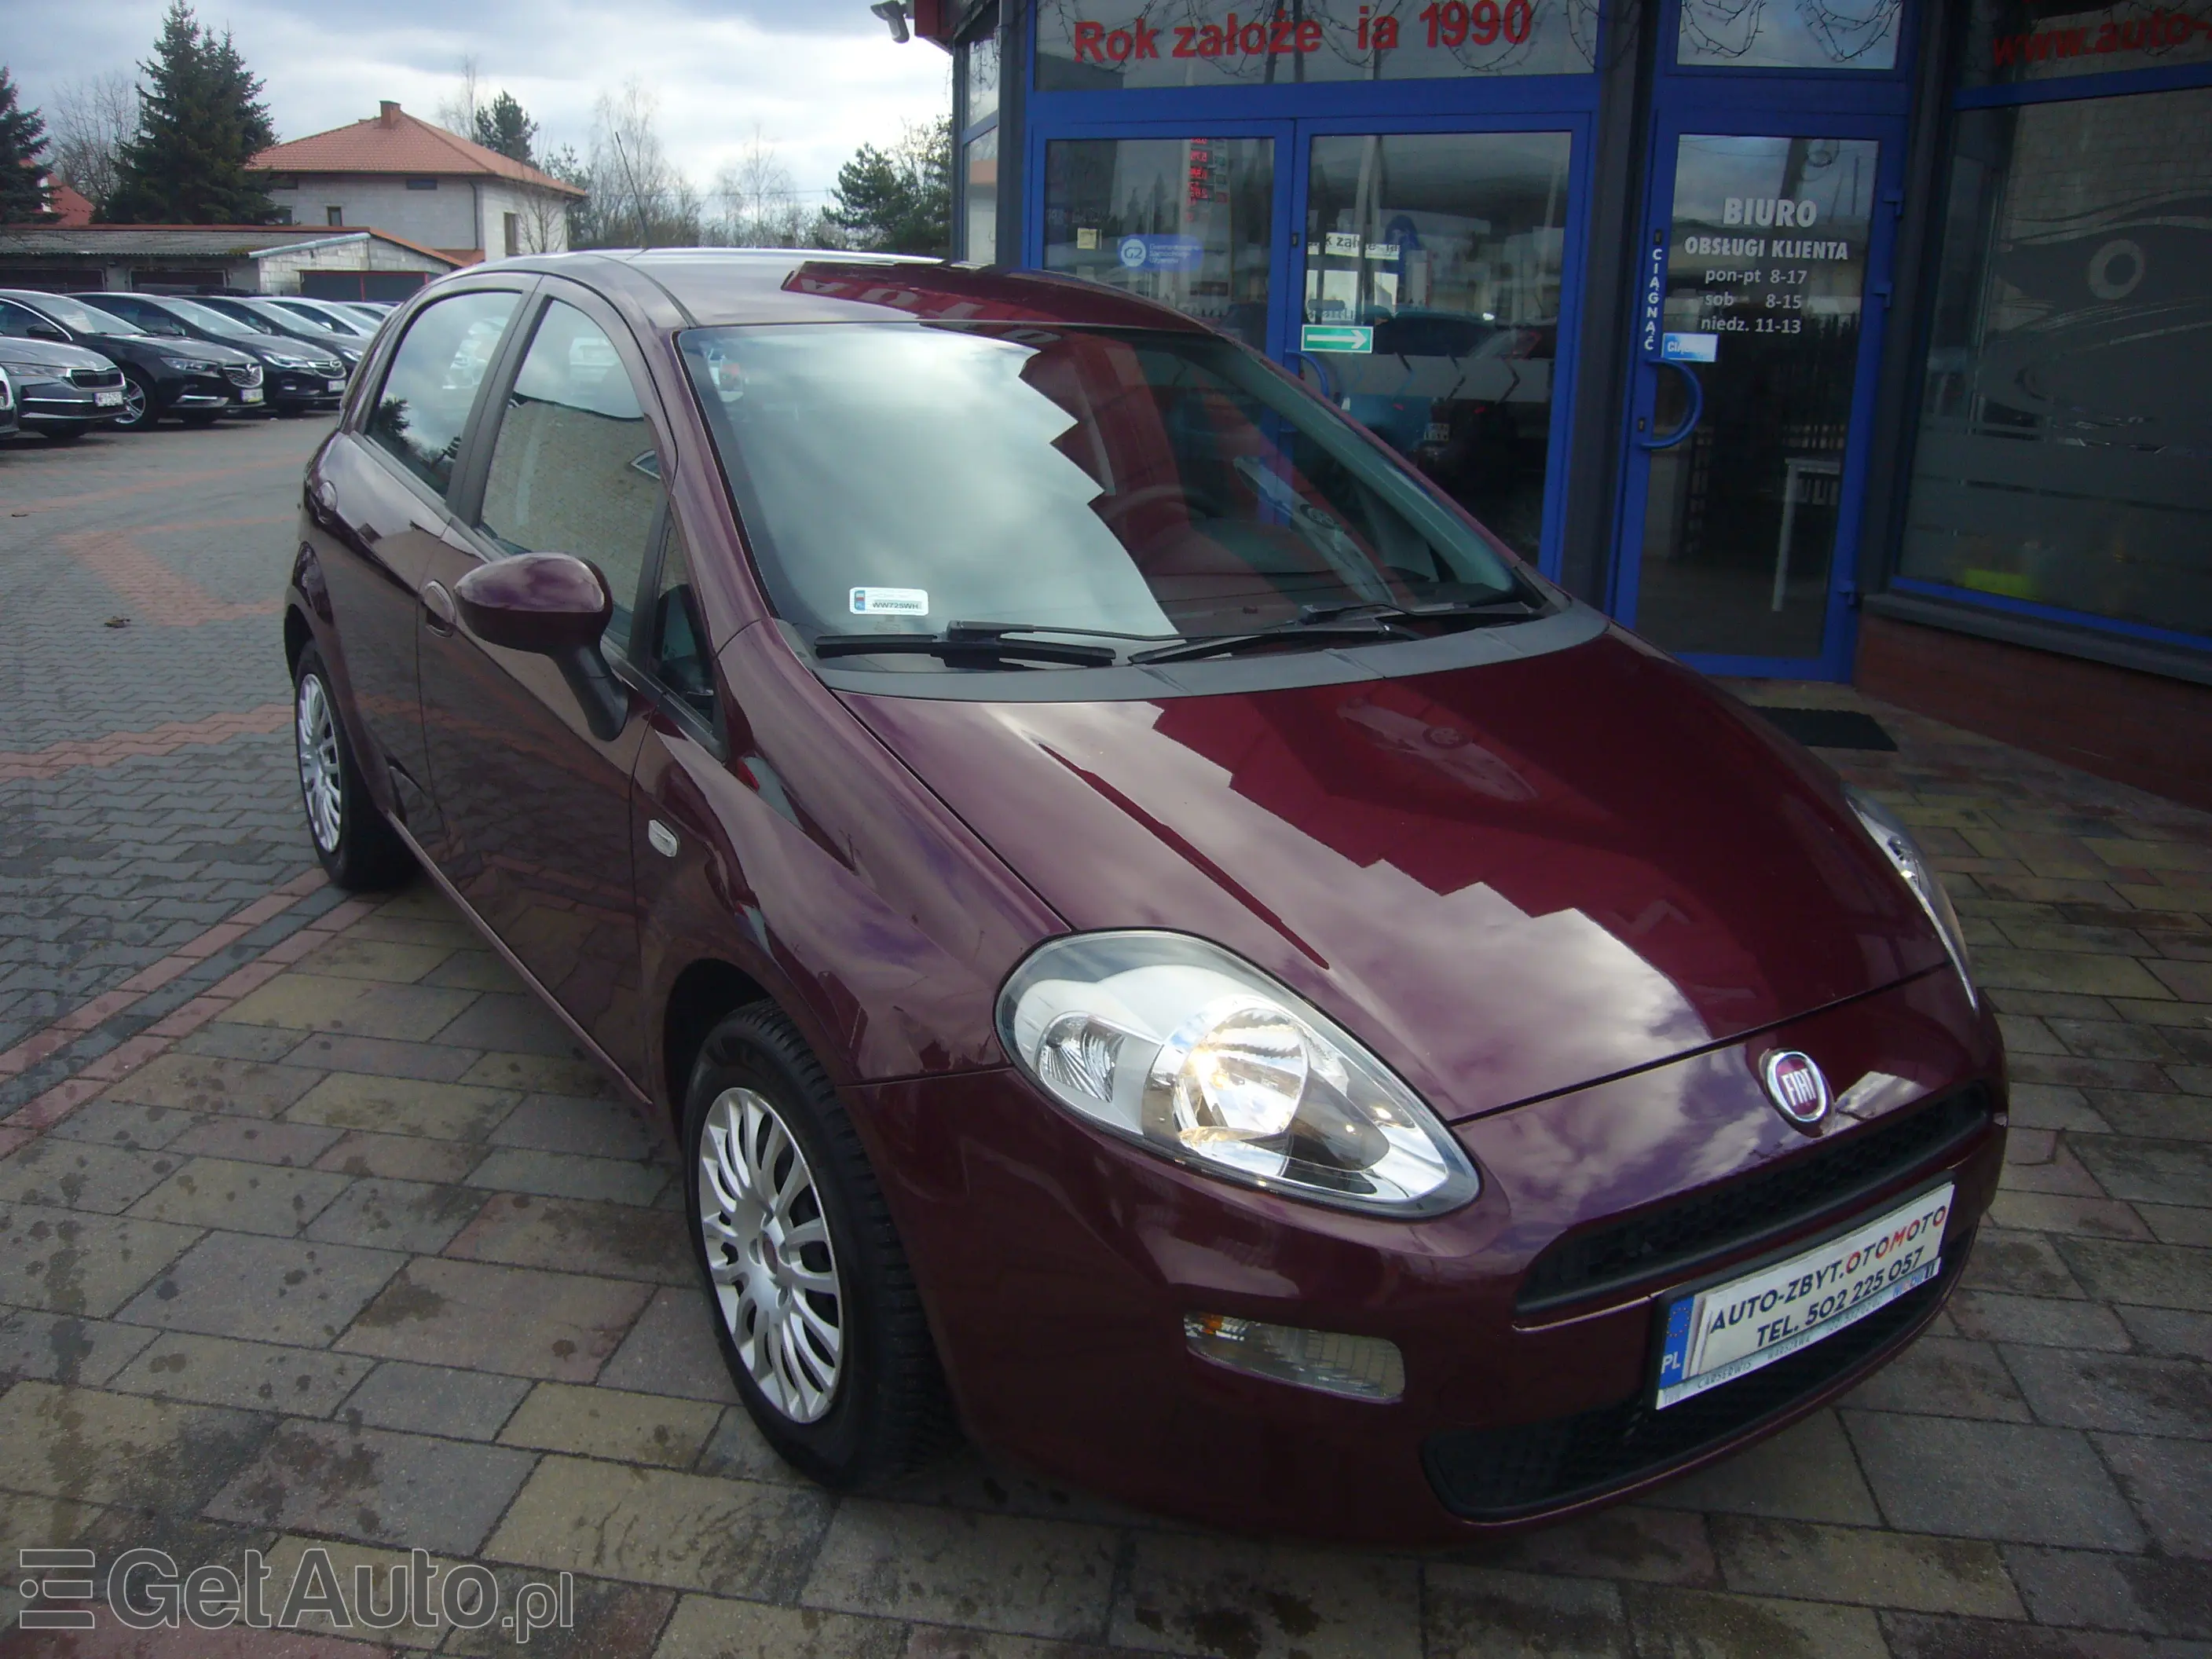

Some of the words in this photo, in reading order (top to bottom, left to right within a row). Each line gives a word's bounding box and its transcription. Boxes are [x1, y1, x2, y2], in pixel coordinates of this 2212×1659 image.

[1074, 17, 1159, 63] Rok
[1172, 9, 1323, 58] założe
[1419, 0, 1532, 48] 1990
[1994, 7, 2212, 67] www.auto-
[1723, 197, 1817, 227] BIURO
[1684, 236, 1766, 257] OBSŁUGI
[1771, 240, 1848, 259] KLIENTA
[1705, 269, 1761, 285] pon-pt
[1770, 269, 1807, 284] 8-17
[1705, 291, 1734, 306] sob
[1765, 294, 1802, 309] 8-15
[1701, 316, 1749, 331] niedz.
[1755, 318, 1801, 333] 11-13
[1781, 1068, 1817, 1107] FIAT
[1709, 1205, 1946, 1334] AUTO-ZBYT.OTOMOTO
[1757, 1315, 1799, 1347] TEL.
[1805, 1289, 1848, 1325] 502
[1849, 1268, 1885, 1305] 225
[1888, 1245, 1925, 1281] 057
[1661, 1351, 1680, 1374] PL
